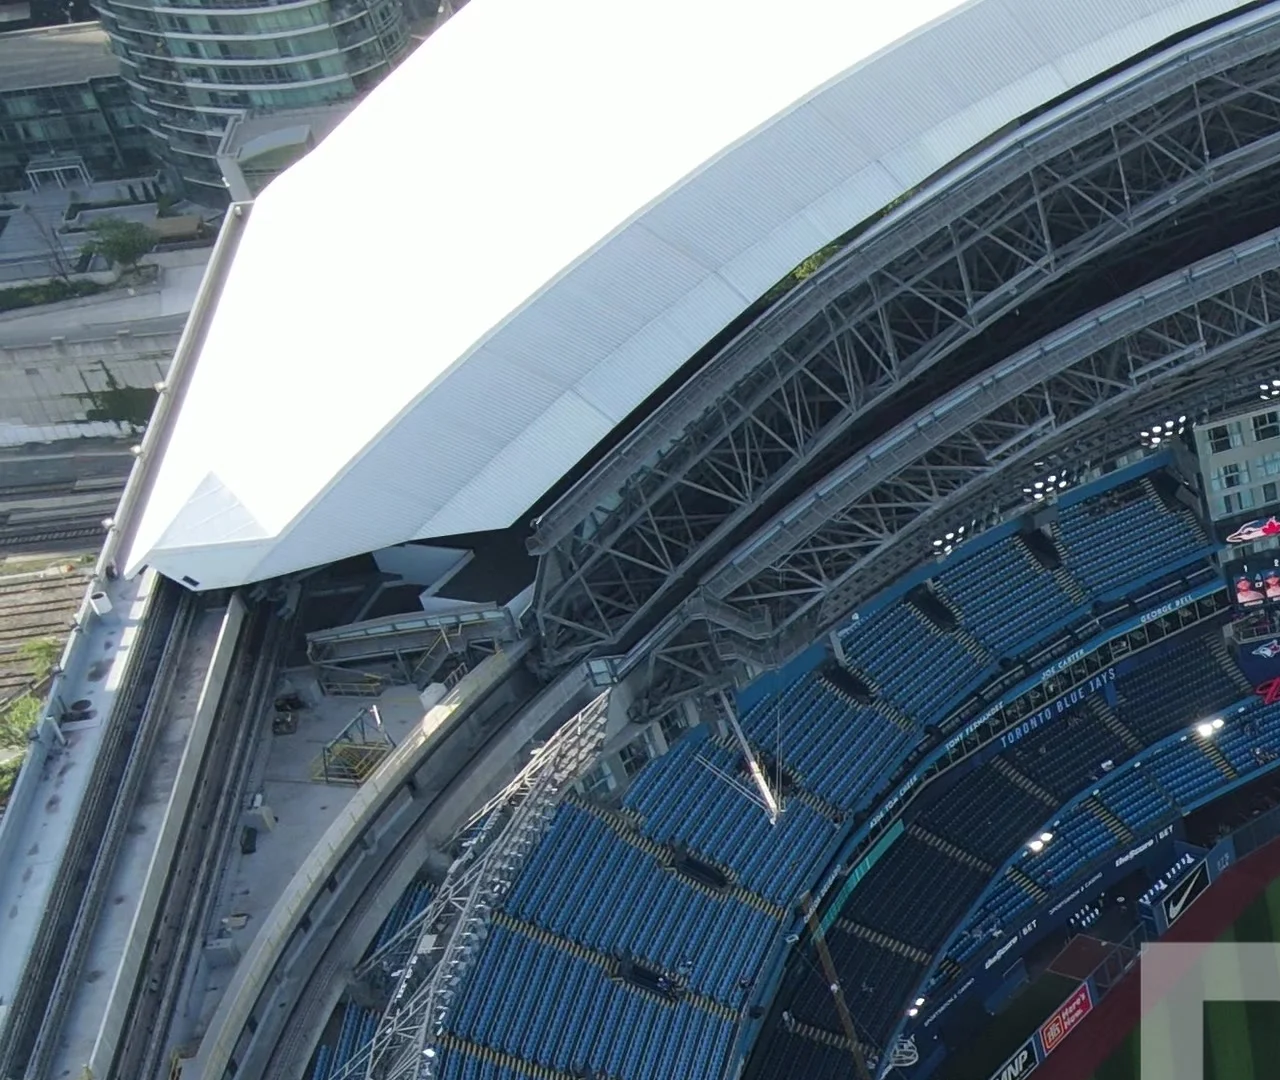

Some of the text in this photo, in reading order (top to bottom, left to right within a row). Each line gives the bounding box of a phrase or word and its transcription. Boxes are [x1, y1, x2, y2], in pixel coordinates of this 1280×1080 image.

[1000, 667, 1117, 749] TORONTO BLUE JAYS
[1159, 824, 1174, 840] BET
[1022, 919, 1037, 936] BET
